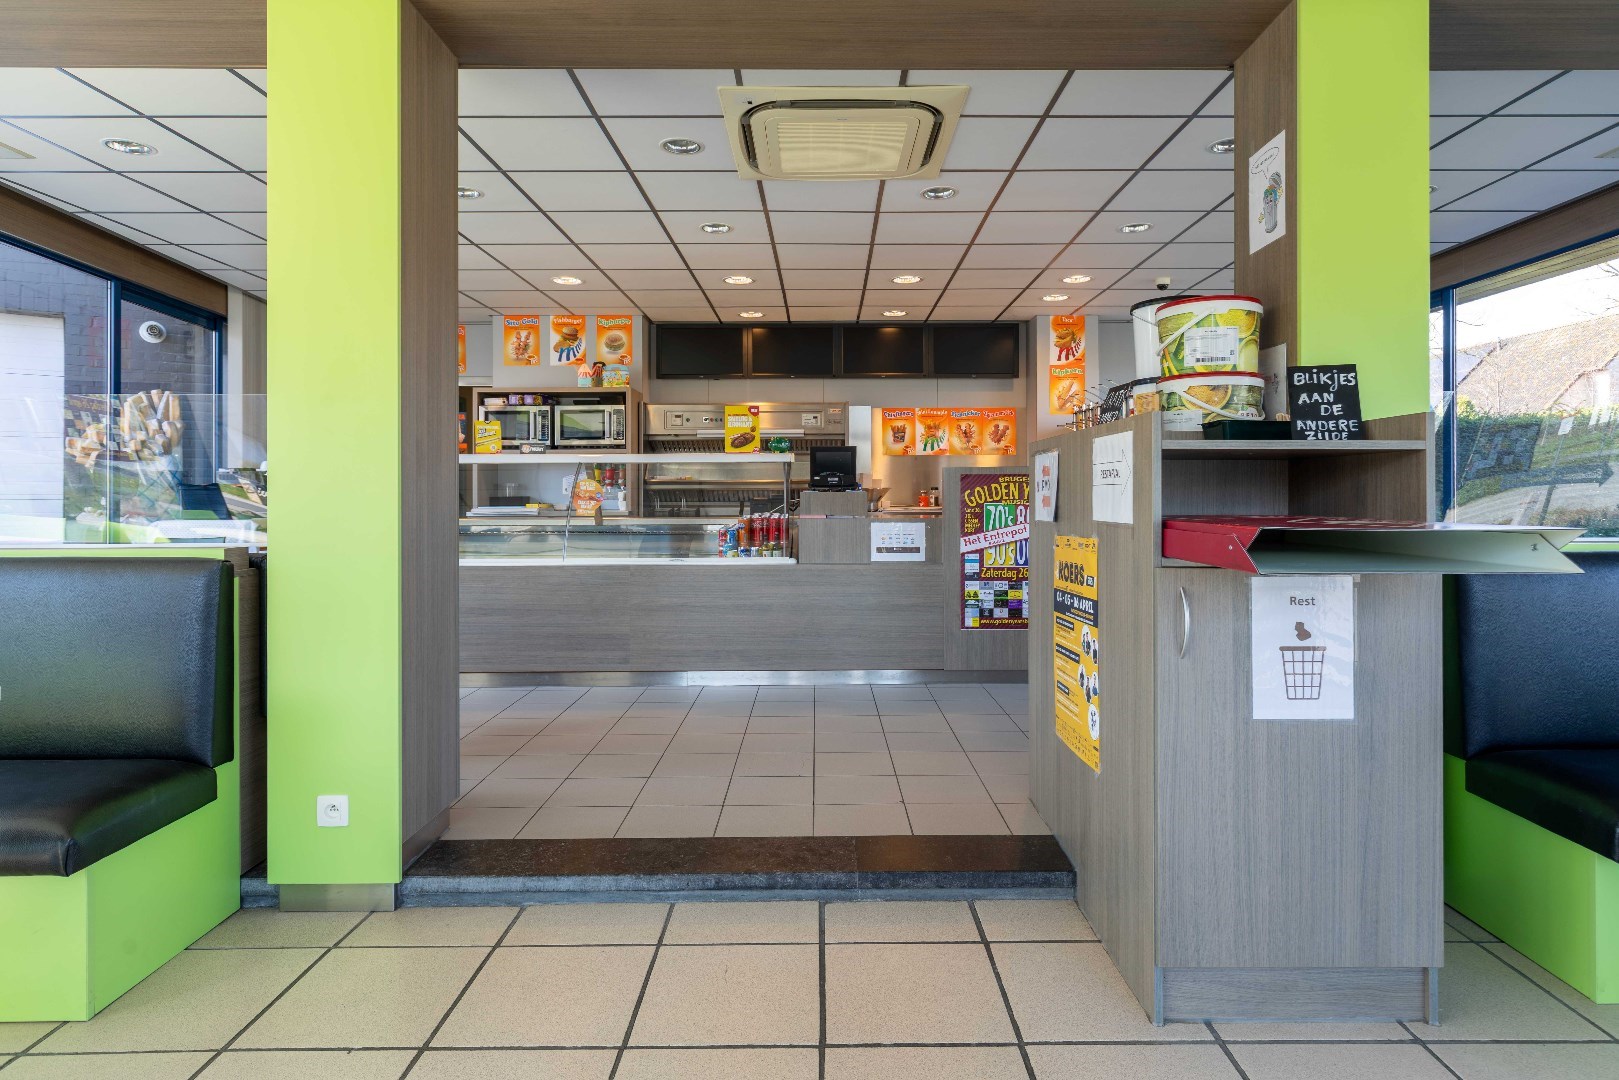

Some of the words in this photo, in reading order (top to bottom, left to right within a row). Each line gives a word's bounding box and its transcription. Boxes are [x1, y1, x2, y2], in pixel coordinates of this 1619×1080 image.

[522, 317, 539, 325] Gold
[1298, 392, 1334, 405] AAN
[1320, 404, 1343, 416] DE
[1296, 420, 1359, 431] ANDERE
[964, 483, 1019, 507] GOLDEN
[963, 535, 982, 546] Het
[983, 525, 1028, 542] Entrepot
[981, 568, 1017, 580] Zaterdag
[1018, 568, 1028, 578] 26
[1058, 560, 1085, 586] KOERS
[1079, 599, 1094, 614] APRIL
[1290, 597, 1316, 606] Rest
